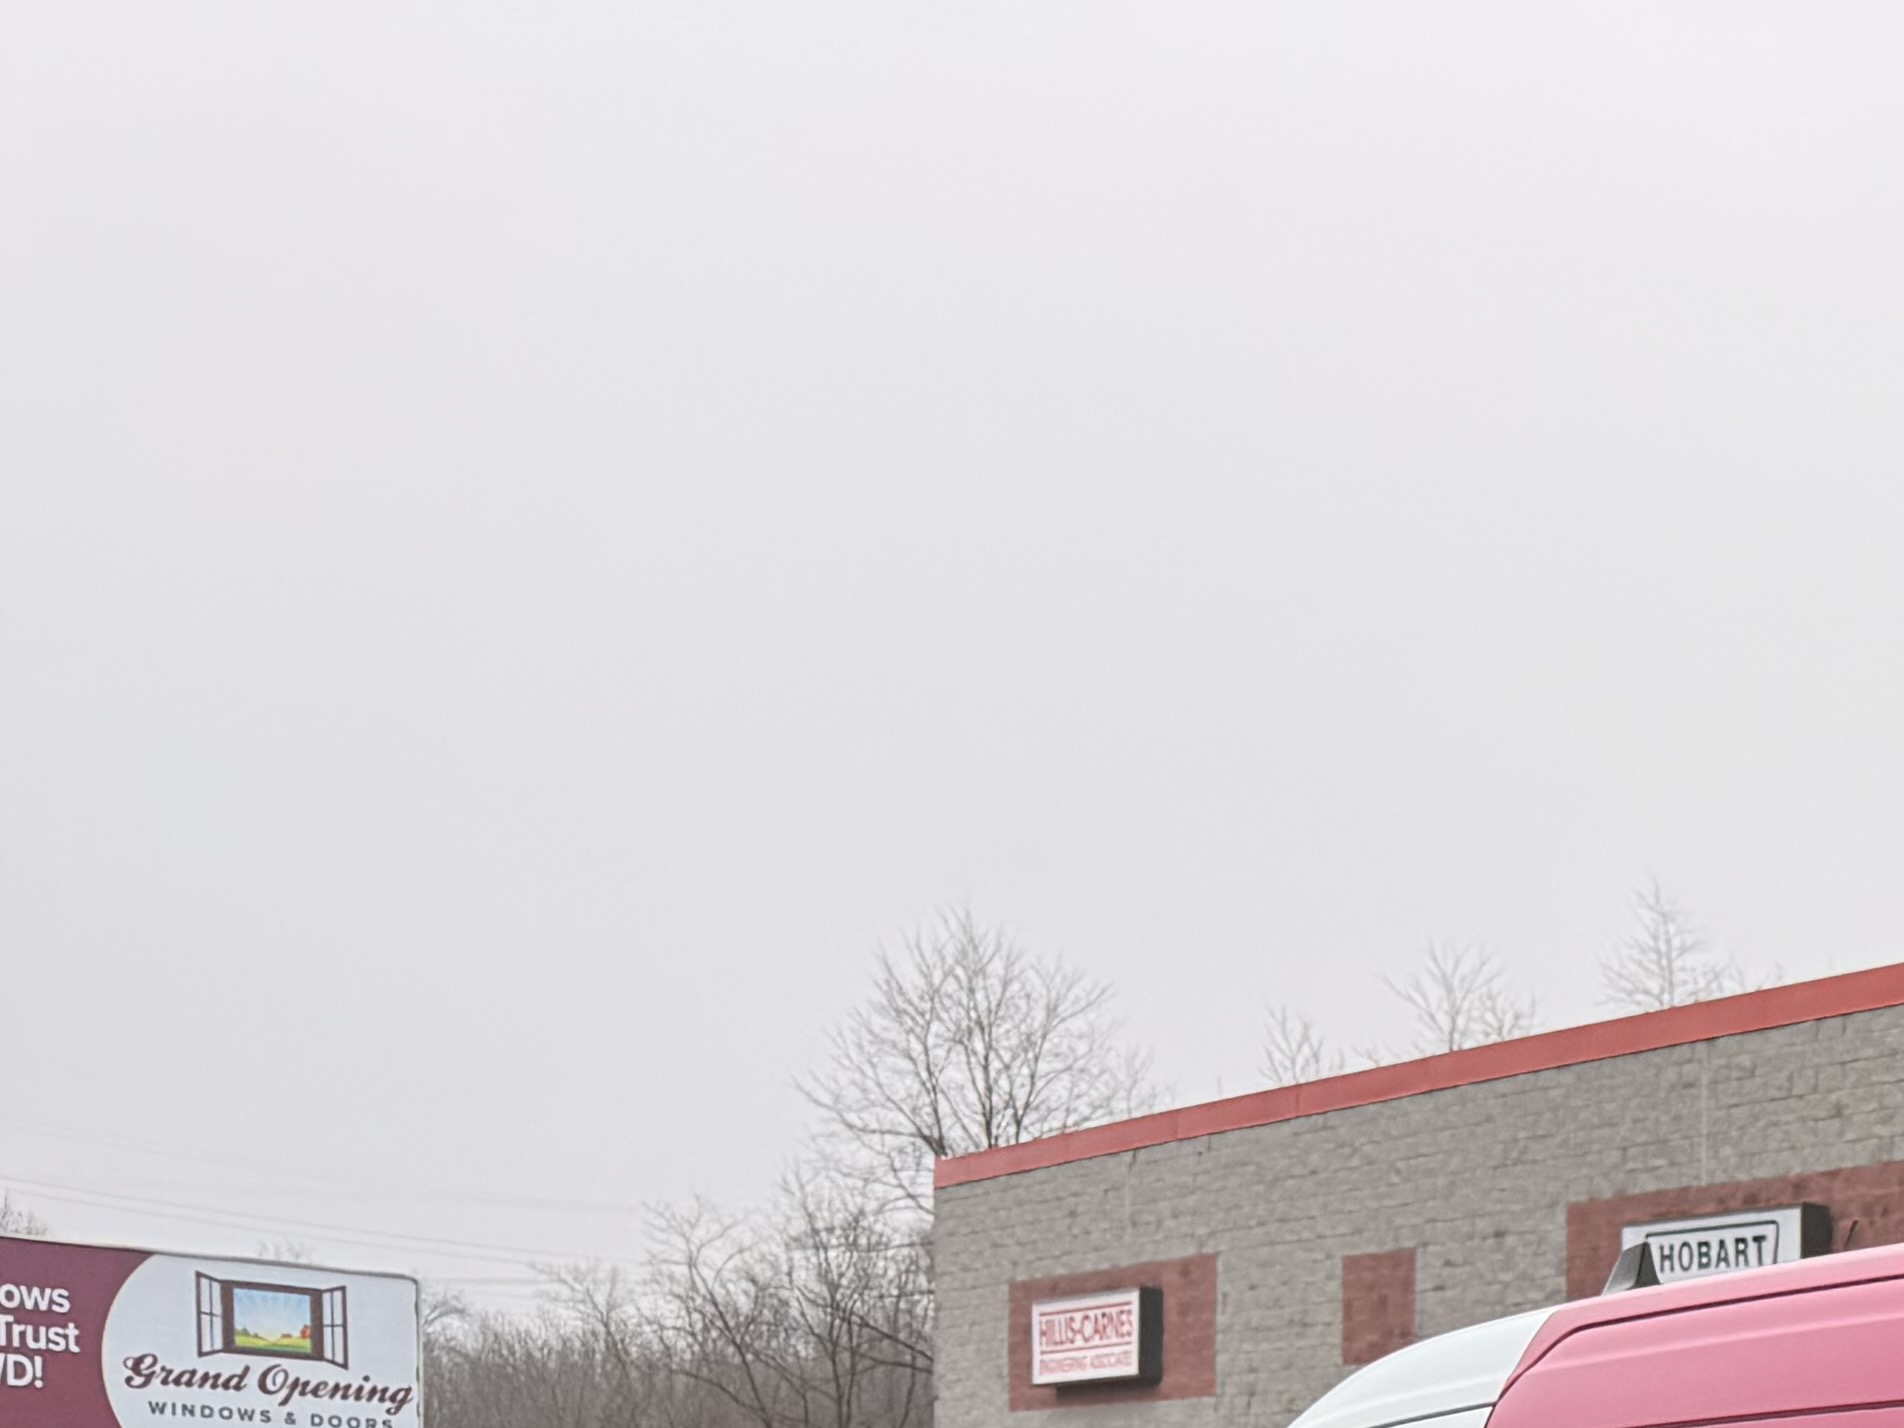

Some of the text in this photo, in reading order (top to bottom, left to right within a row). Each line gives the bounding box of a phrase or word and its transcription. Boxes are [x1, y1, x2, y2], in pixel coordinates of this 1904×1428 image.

[1659, 1235, 1767, 1273] HOBART
[0, 1283, 70, 1313] ows
[123, 1353, 414, 1416] Grand Opening
[148, 1401, 271, 1423] WINDOWS
[285, 1412, 297, 1425] &
